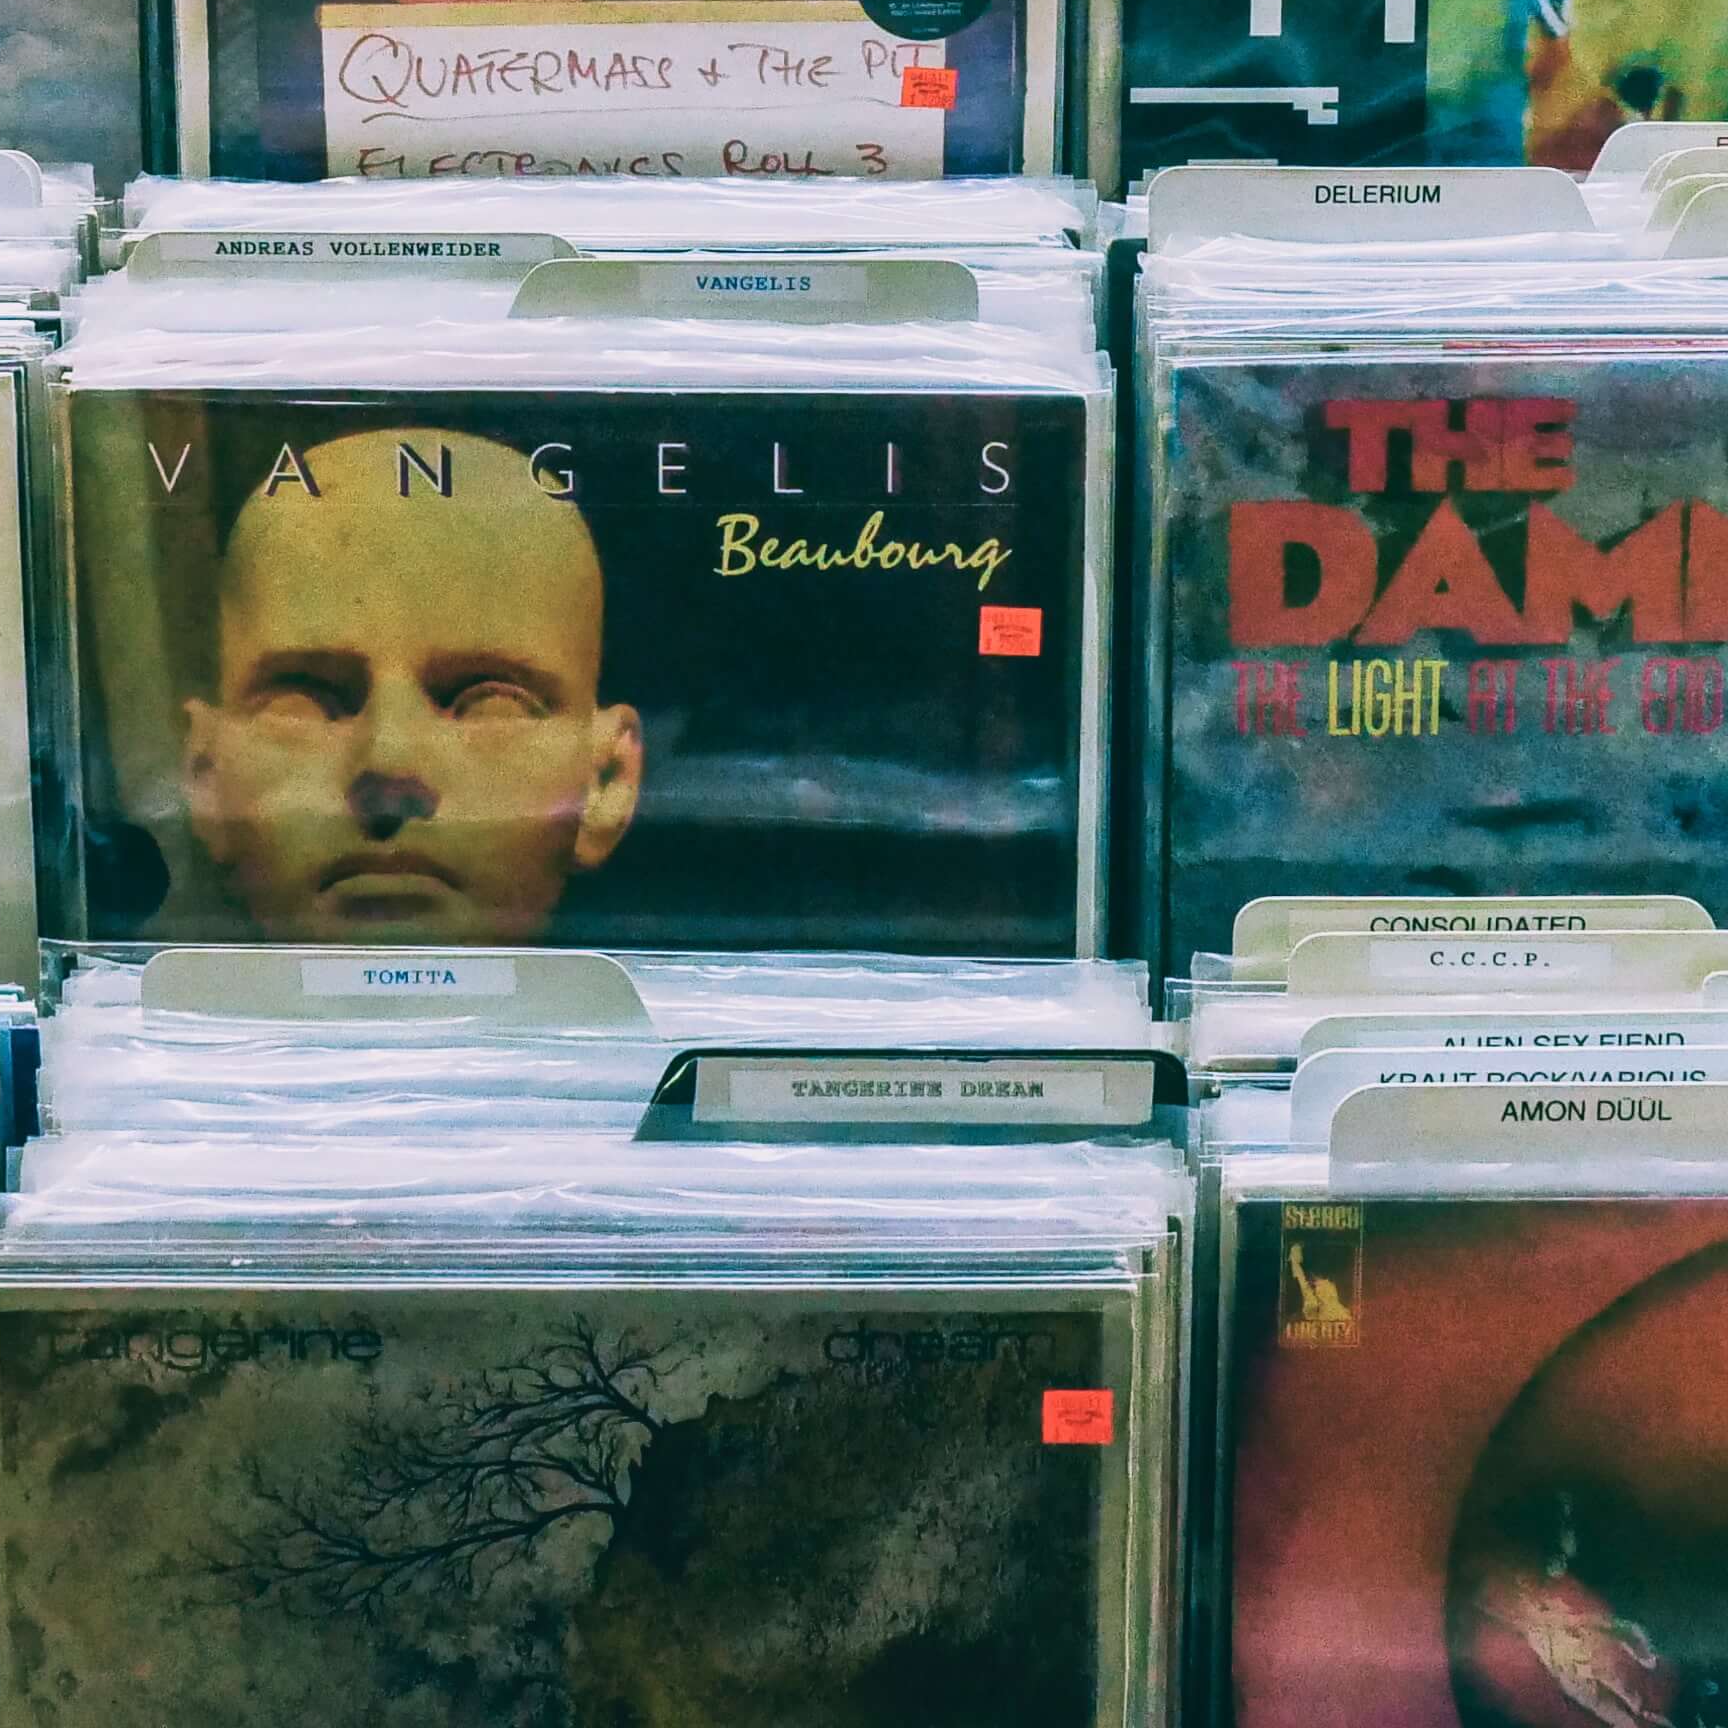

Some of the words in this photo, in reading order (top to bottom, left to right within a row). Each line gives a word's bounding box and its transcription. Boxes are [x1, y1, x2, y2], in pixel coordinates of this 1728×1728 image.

[339, 33, 676, 107] QUATERMASS
[729, 40, 835, 88] THE
[1314, 185, 1441, 205] DELERIUM
[215, 241, 315, 257] ANDREAS
[329, 241, 502, 258] VOLLENWEIDER
[696, 276, 812, 291] VANGELIS
[1326, 398, 1576, 493] THE
[146, 441, 1011, 498] VANGELIS
[713, 511, 1011, 591] Beaubourg
[1232, 660, 1306, 734] THE
[1326, 660, 1449, 735] LIGHT
[1466, 660, 1518, 734] AT
[1540, 658, 1612, 735] THE
[1640, 658, 1722, 734] END
[1430, 952, 1550, 967] C.C.C.P.
[363, 968, 457, 986] TOMITA
[791, 1080, 942, 1098] TANGERINE
[960, 1080, 1044, 1098] DREAM
[1501, 1101, 1586, 1122] AMON
[1596, 1096, 1672, 1122] DÜÜL
